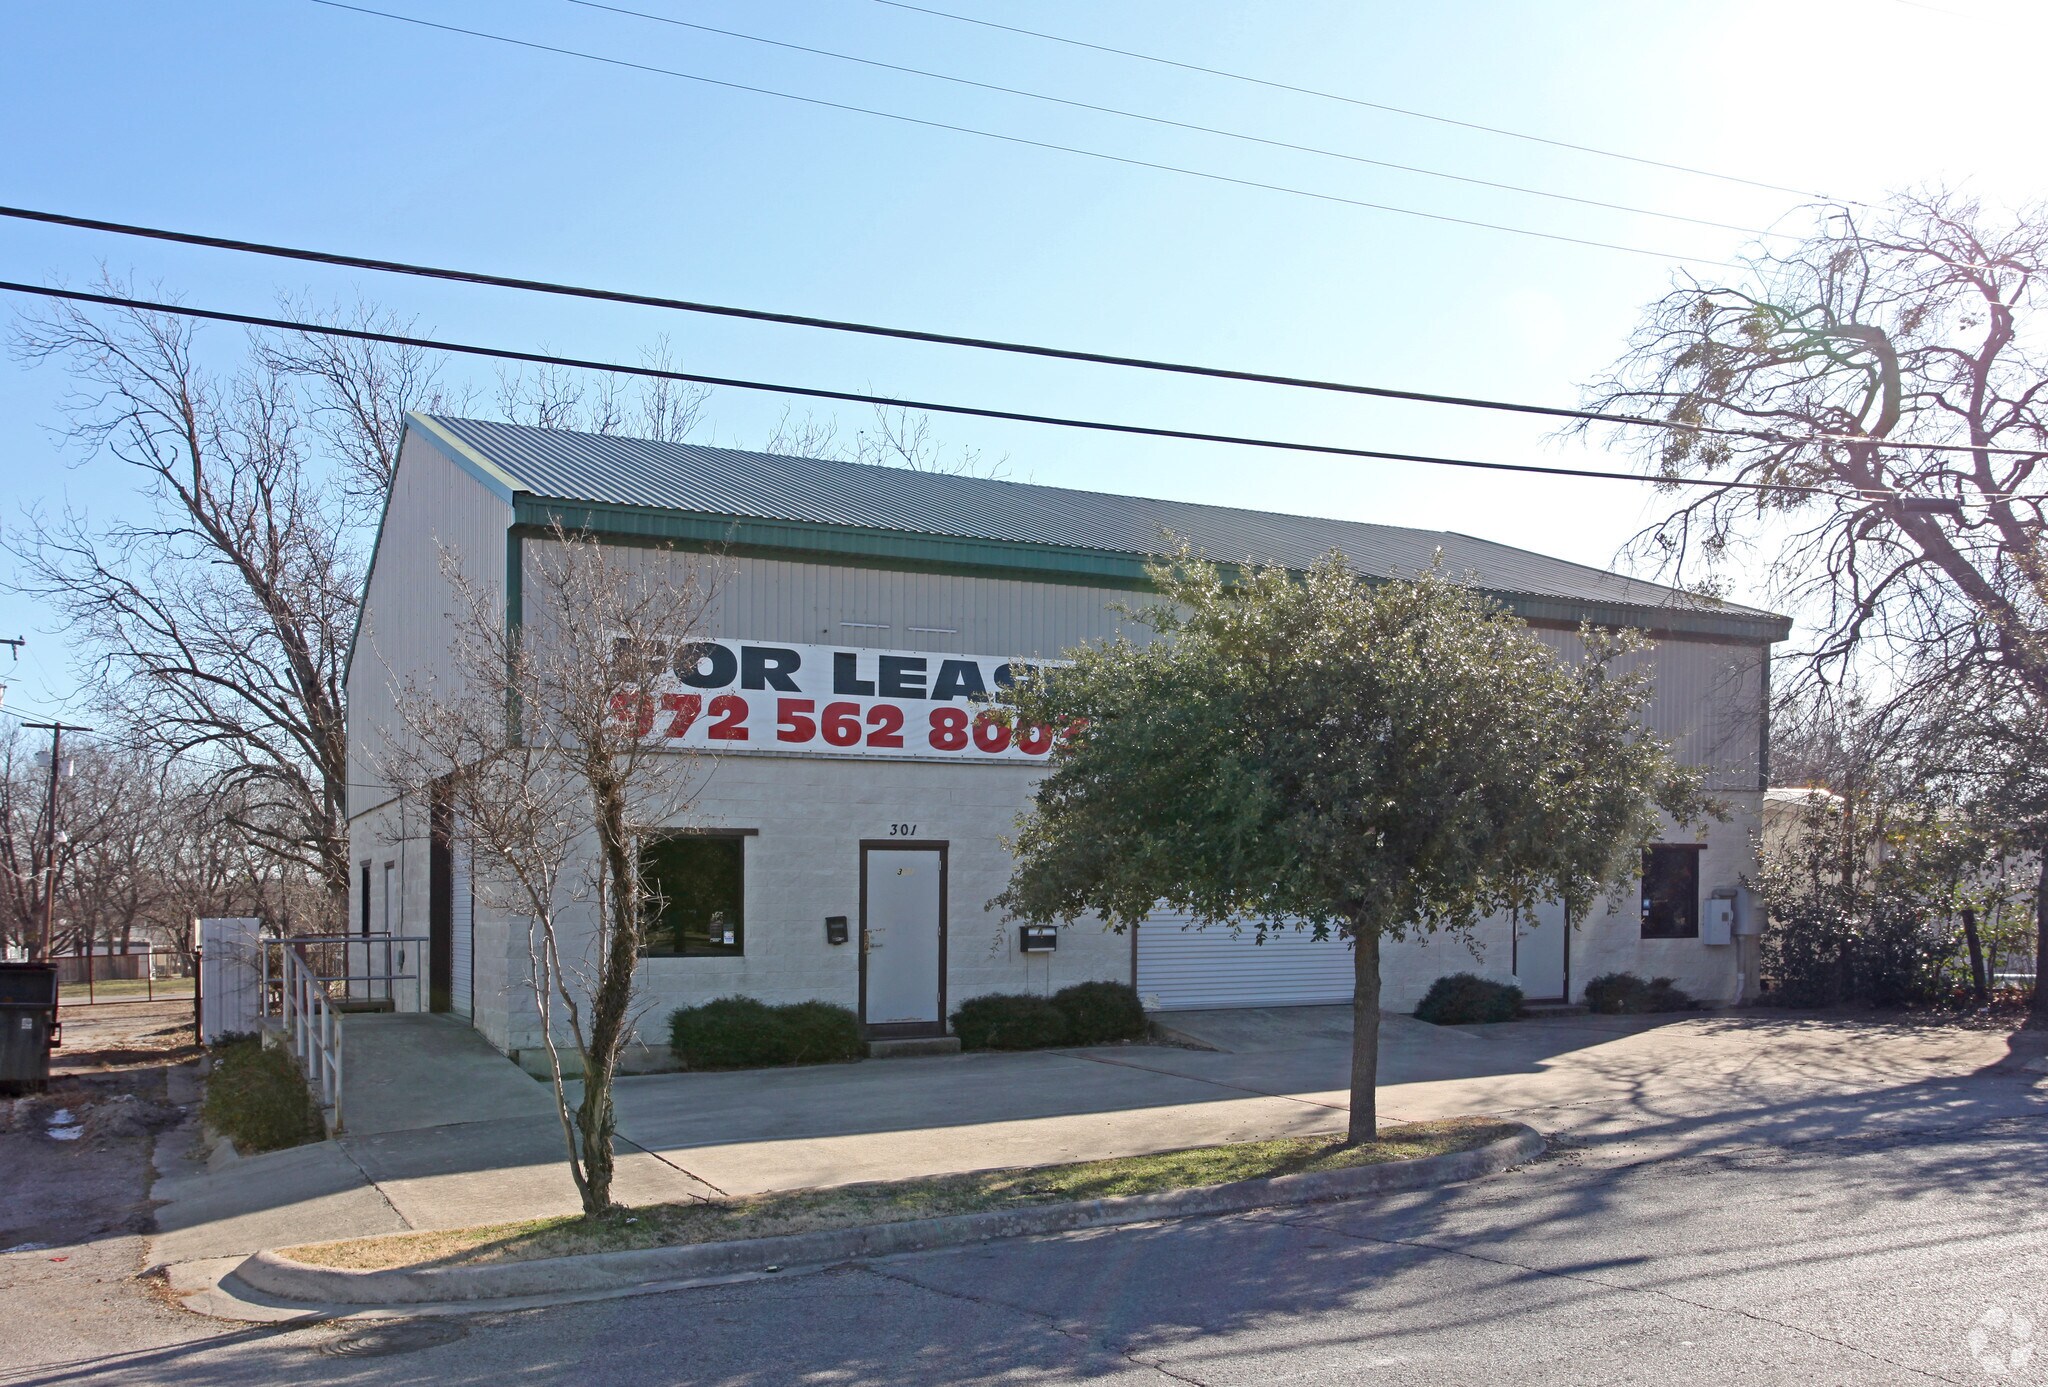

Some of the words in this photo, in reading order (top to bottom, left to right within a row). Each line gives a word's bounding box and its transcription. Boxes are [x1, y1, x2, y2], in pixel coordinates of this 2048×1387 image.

[834, 652, 1082, 707] LEAS
[777, 697, 905, 748] 562
[889, 823, 917, 836] 301
